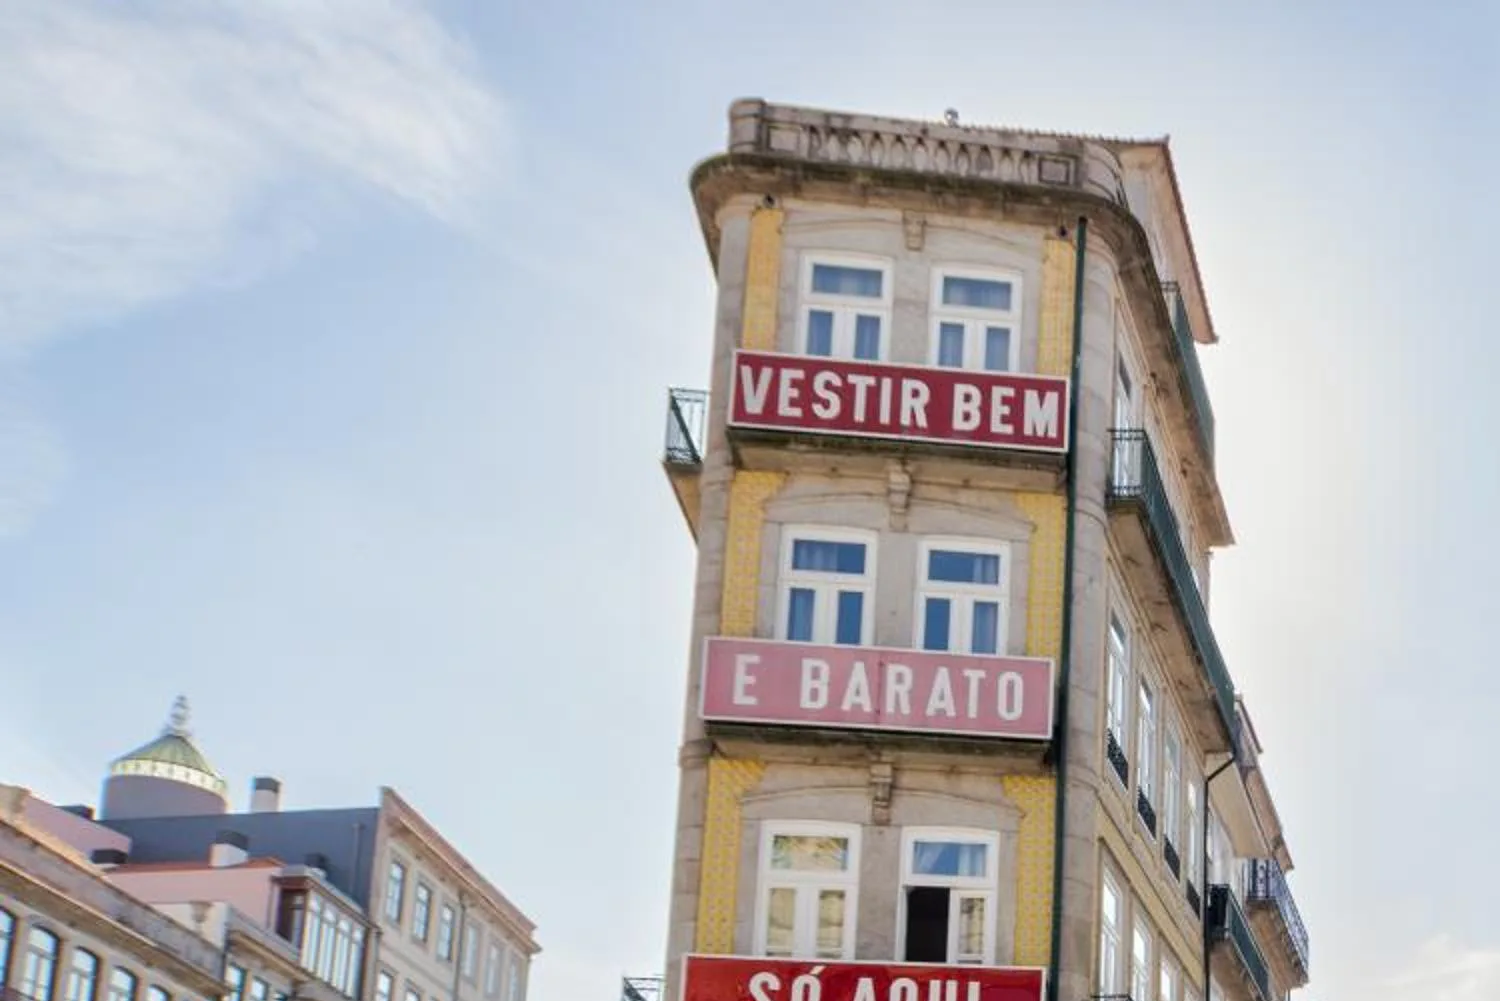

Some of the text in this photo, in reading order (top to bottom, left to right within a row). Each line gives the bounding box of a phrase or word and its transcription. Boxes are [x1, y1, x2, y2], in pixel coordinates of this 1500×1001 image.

[739, 364, 1060, 439] VESTIR BEM
[732, 653, 1025, 721] E BARATO
